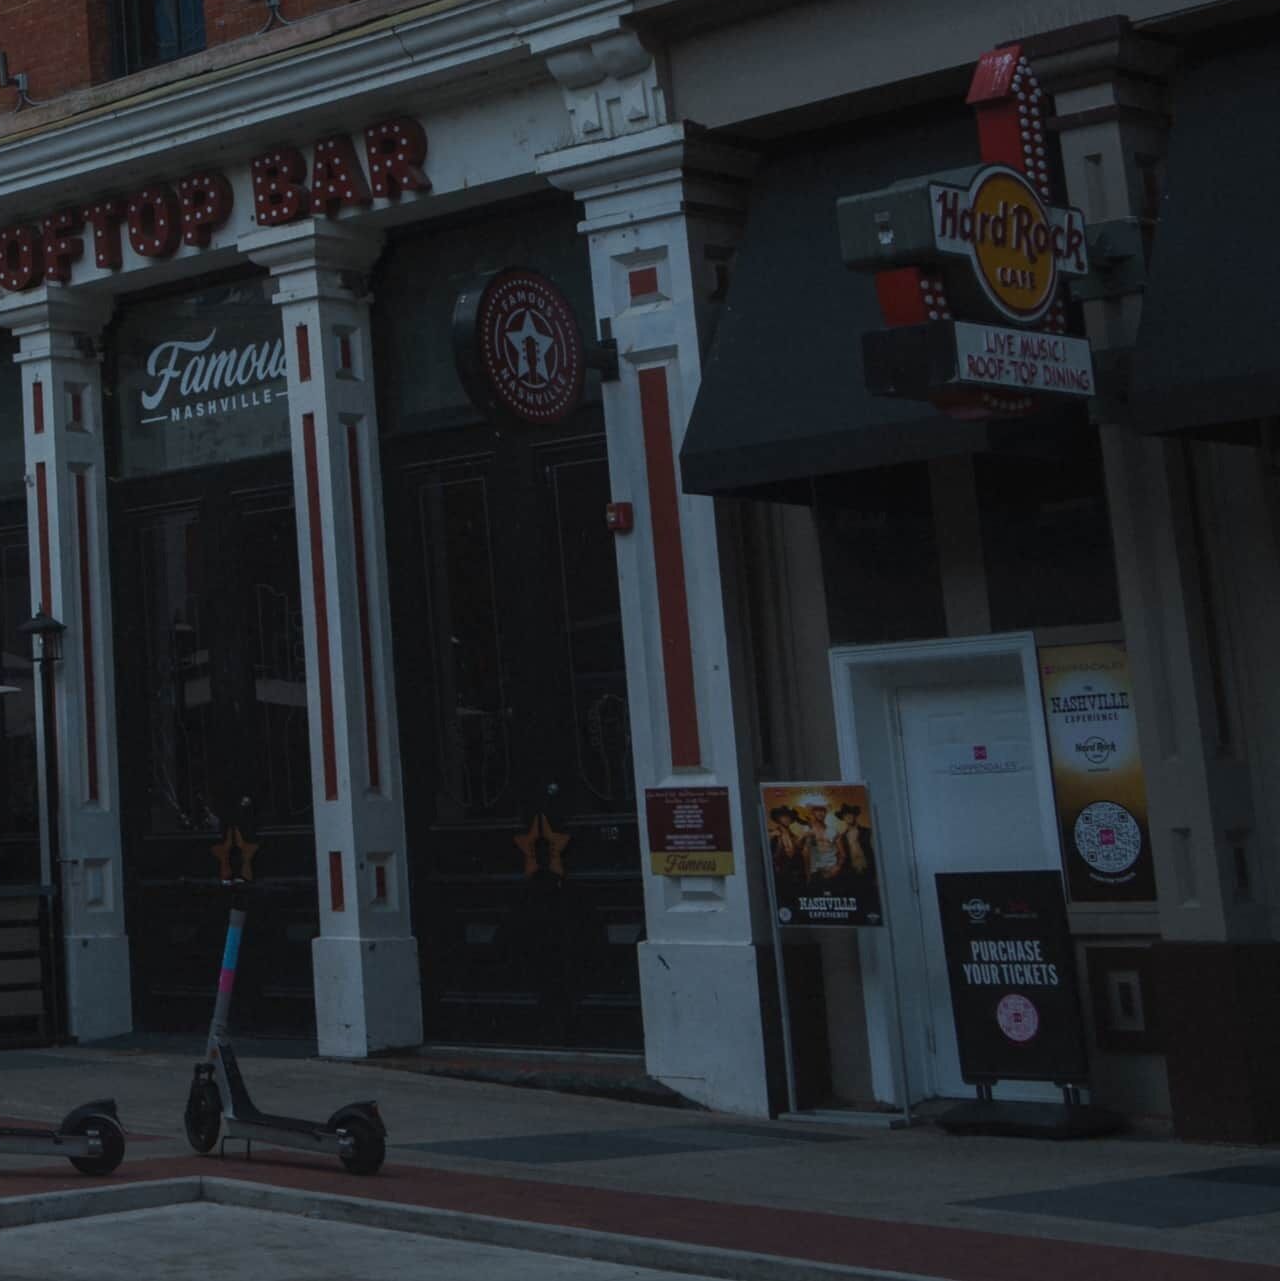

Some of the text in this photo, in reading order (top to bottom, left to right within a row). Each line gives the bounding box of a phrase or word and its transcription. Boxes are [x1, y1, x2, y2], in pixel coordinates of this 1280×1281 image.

[249, 115, 433, 226] BAR
[936, 191, 1085, 271] Hard Rock
[997, 267, 1036, 289] CAFE
[501, 291, 553, 317] FAMOUS
[985, 331, 1067, 362] LIVE MUSIC!
[500, 368, 567, 405] NASHVILLE
[968, 355, 1090, 390] ROOF-TOP DINING
[170, 389, 272, 422] NASHVILLE
[1051, 692, 1129, 713] NASHVILLE
[798, 897, 857, 910] NASHVILLE
[970, 940, 1043, 962] PURCHASE
[962, 963, 1059, 985] YOUR TICKETS
